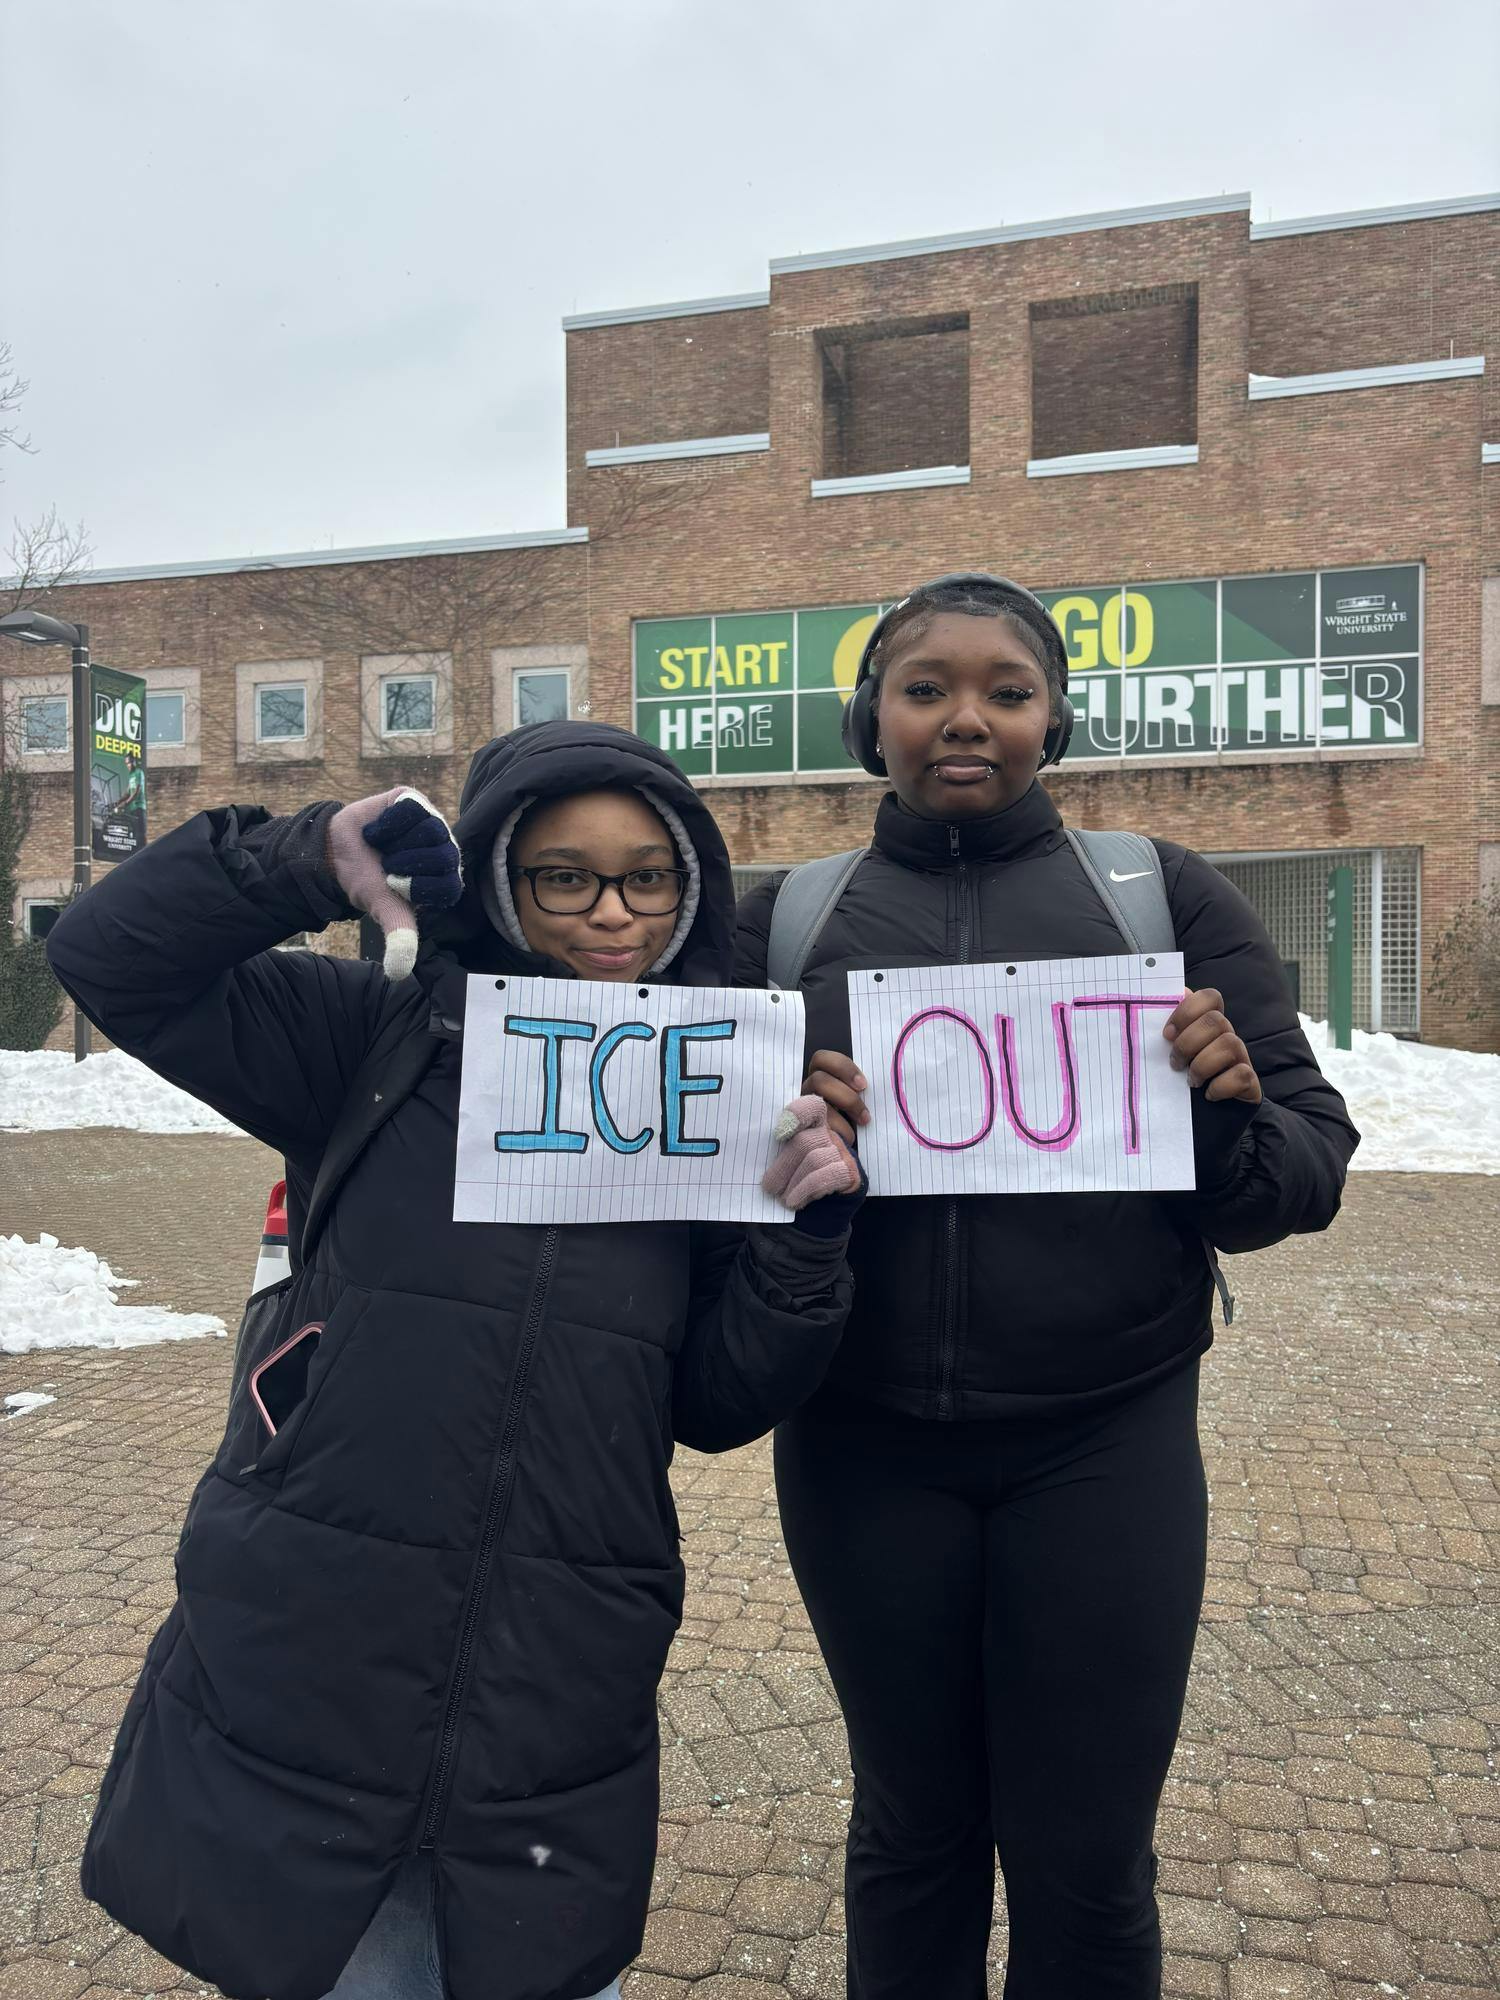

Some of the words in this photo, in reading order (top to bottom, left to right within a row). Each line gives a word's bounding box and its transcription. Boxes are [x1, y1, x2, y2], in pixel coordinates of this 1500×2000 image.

[1051, 592, 1154, 671] GO
[1325, 613, 1372, 627] WRIGHT
[1374, 611, 1407, 624] STATE
[1336, 622, 1395, 635] UNIVERSITY
[659, 641, 788, 690] START
[95, 693, 142, 741] DIG
[658, 703, 774, 751] HERE
[1068, 663, 1406, 751] URTHER
[494, 1015, 737, 1157] ICE
[890, 993, 1186, 1155] OUT
